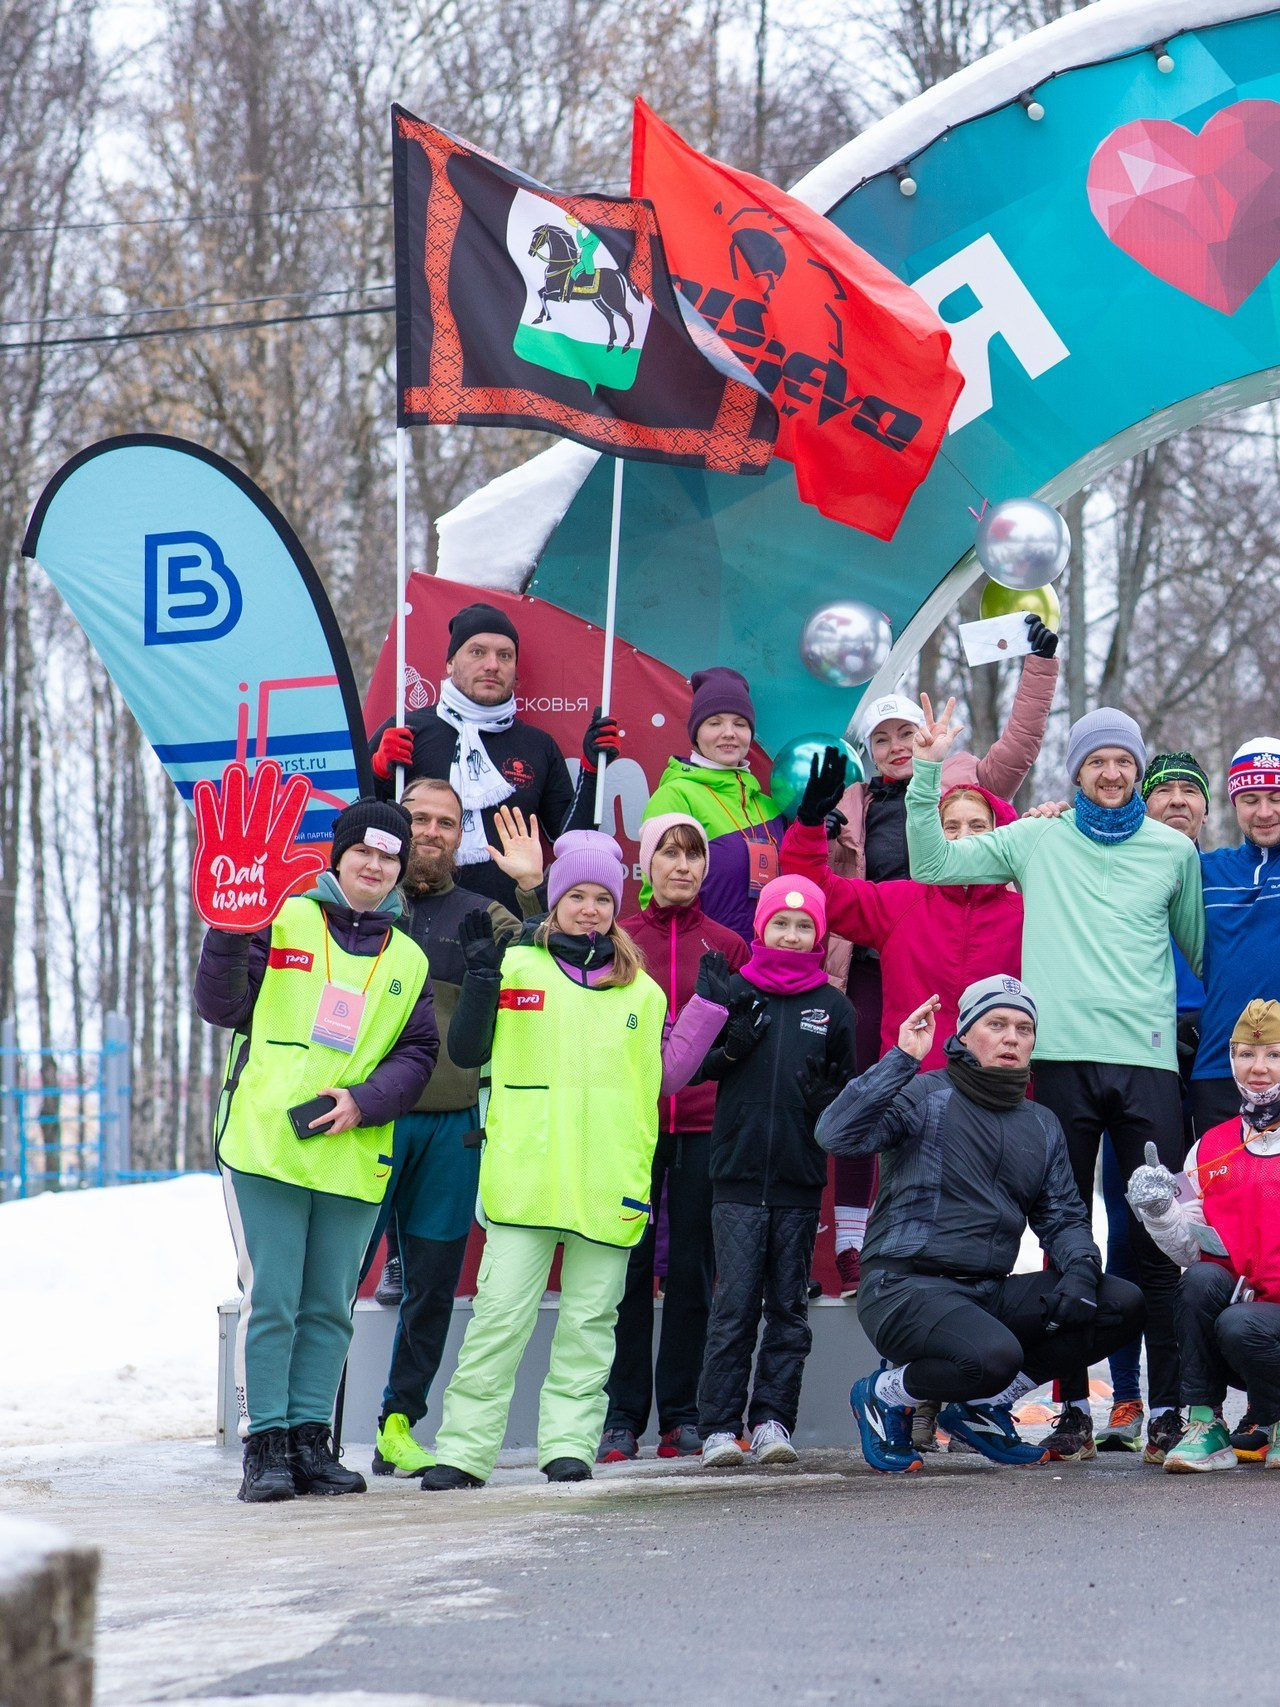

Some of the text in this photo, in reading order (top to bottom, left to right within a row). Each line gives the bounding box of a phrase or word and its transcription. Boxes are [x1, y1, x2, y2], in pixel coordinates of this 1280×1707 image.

[909, 232, 1071, 434] Я
[514, 697, 589, 712] СКОВЬЯ
[1229, 774, 1265, 791] ЖНЯ
[306, 831, 335, 839] ПАРТНЕ
[210, 852, 268, 887] Дай
[211, 887, 268, 912] пять
